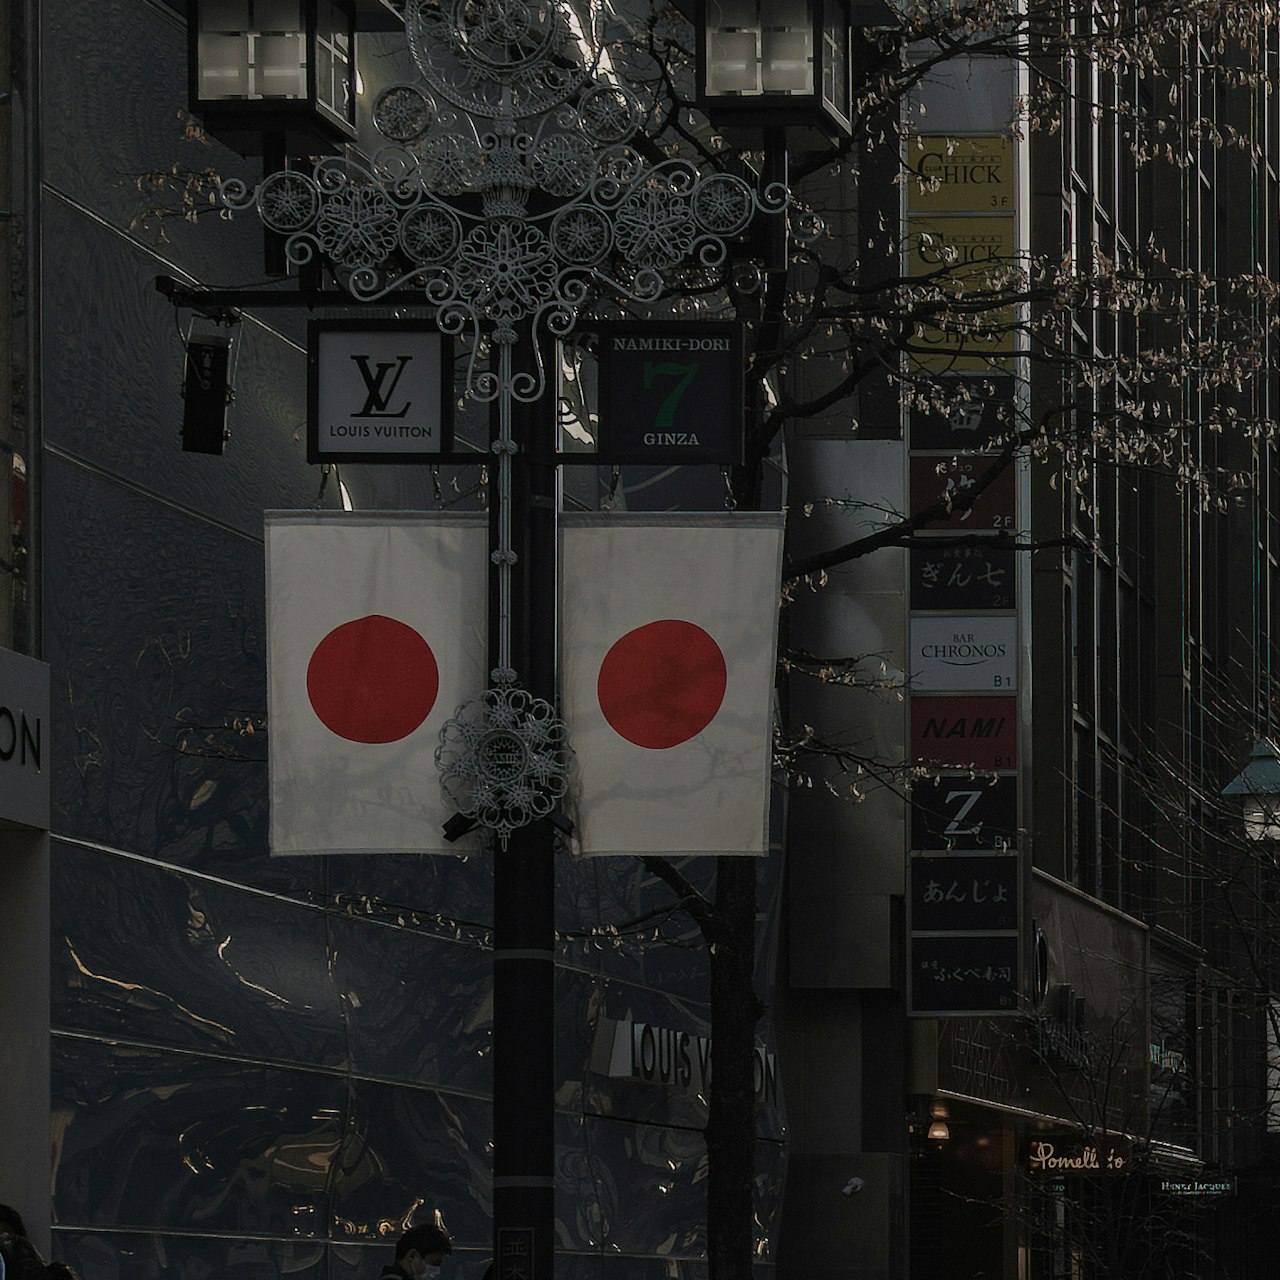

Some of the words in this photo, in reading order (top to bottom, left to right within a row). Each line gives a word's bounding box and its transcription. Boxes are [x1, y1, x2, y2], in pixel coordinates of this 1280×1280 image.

[991, 196, 1008, 206] 3F
[613, 337, 731, 352] NAMIKI-DORI
[642, 361, 702, 428] 7
[330, 424, 370, 438] LOUIS
[373, 425, 432, 439] VUITTON
[643, 431, 701, 446] GINZA
[993, 515, 1012, 528] 2F
[921, 562, 1006, 588] ぎん七
[993, 596, 1011, 607] 2F
[953, 634, 975, 643] BAR
[921, 644, 1006, 658] CHRONOS
[994, 675, 1012, 687] B1
[923, 718, 1006, 738] NAMI
[994, 756, 1012, 767] B1
[944, 790, 984, 835] Z
[632, 1021, 692, 1088] LOUIS
[1029, 1141, 1126, 1170] Pomellto
